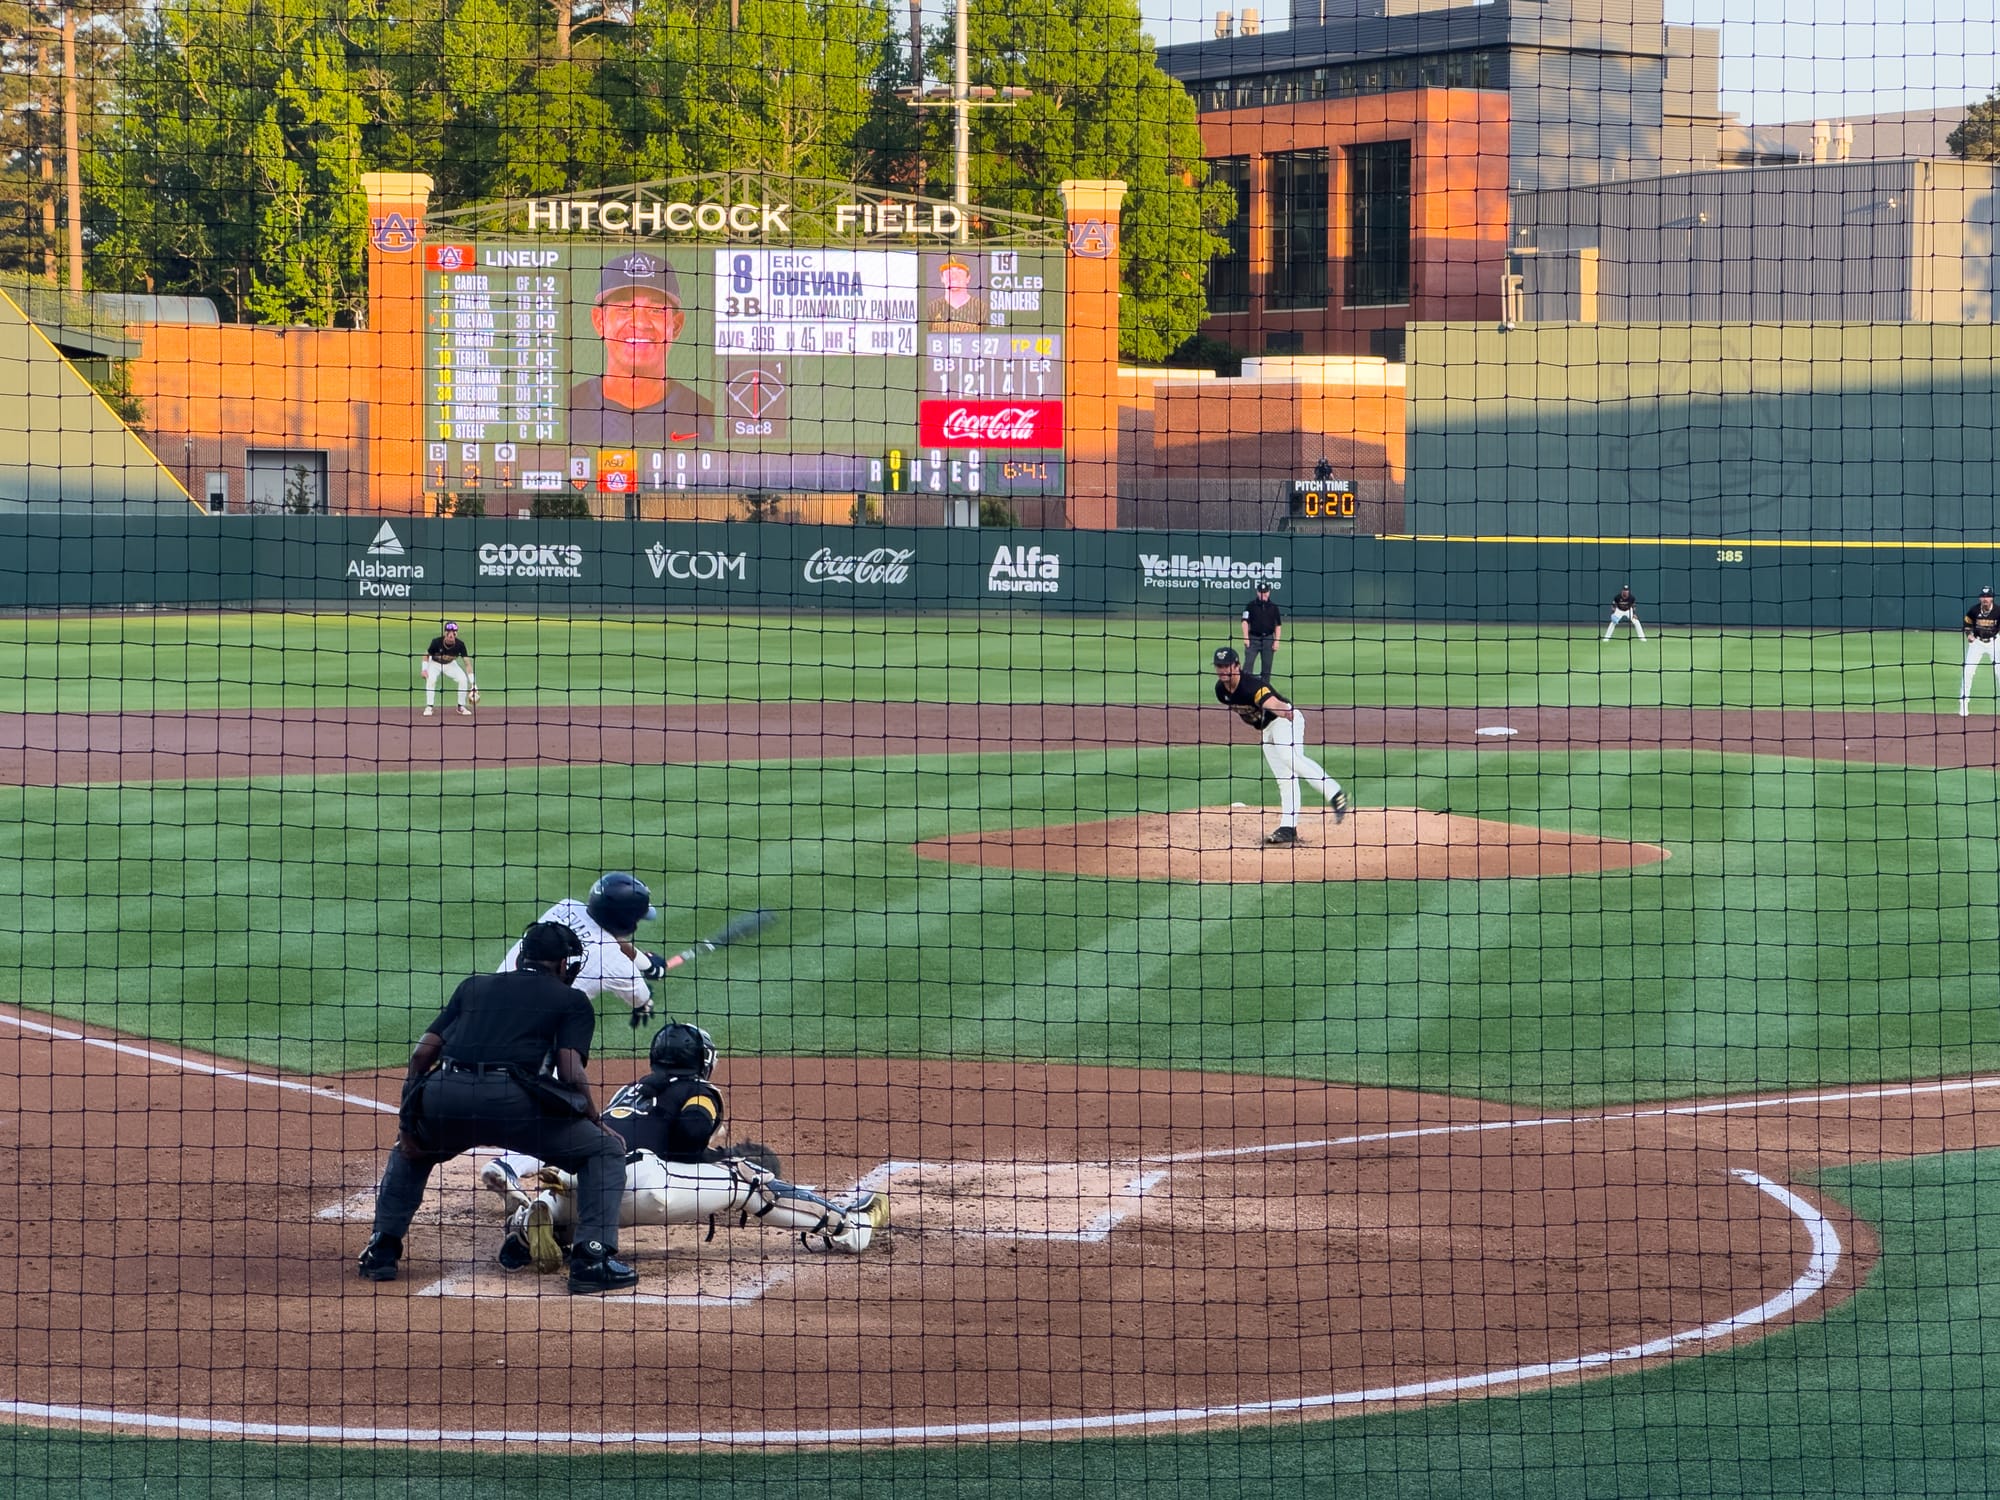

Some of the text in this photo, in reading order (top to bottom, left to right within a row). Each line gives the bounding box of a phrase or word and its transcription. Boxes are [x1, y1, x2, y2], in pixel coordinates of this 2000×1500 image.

[527, 200, 962, 233] HITCHCOCK FIELD
[485, 250, 559, 267] LINEUP
[773, 255, 813, 269] ERIC
[998, 253, 1012, 271] 19
[733, 254, 753, 294] 8
[990, 276, 1043, 289] CALEB
[455, 275, 488, 290] CARTER
[536, 276, 555, 291] 1-2
[772, 271, 863, 297] GUEVARA
[724, 297, 761, 317] 3B
[990, 291, 1039, 311] SANDERS
[772, 300, 784, 319] JR
[796, 300, 840, 319] PANAMA
[871, 300, 916, 320] PANAMA
[455, 313, 494, 328] GUEVARA
[516, 314, 530, 329] 3B
[536, 314, 555, 329] 0-0
[990, 313, 1005, 327] SR
[718, 330, 745, 347] AVG
[801, 327, 816, 352] 45
[825, 331, 843, 348] HR
[848, 327, 856, 352] 5
[871, 331, 894, 348] RBI
[898, 327, 912, 353] 24
[932, 340, 943, 352] B
[971, 340, 980, 352] S
[984, 338, 999, 355] 27
[1011, 339, 1030, 352] TP
[455, 351, 490, 365] TERRELL
[518, 352, 528, 366] LF
[536, 352, 553, 366] 0-1
[933, 359, 1051, 372] BB IP H ER
[776, 362, 783, 374] 1
[940, 374, 948, 396] 1
[964, 374, 985, 396] 2.1
[1037, 374, 1043, 395] 1
[455, 387, 498, 401] GREGORIO
[517, 406, 530, 421] SS
[455, 424, 485, 438] STEELE
[520, 425, 527, 439] C
[735, 421, 772, 434] Sac8
[943, 408, 1040, 440] Coca-Cola
[432, 446, 443, 459] B
[466, 446, 476, 459] S
[653, 453, 711, 469] 0 0 0
[436, 465, 444, 487] 1
[464, 465, 480, 487] 2
[576, 461, 584, 476] 3
[871, 461, 881, 481] R
[952, 461, 961, 482] E
[1003, 462, 1048, 480] 6:41
[654, 472, 686, 489] 1 0
[891, 471, 899, 491] 1
[930, 471, 941, 491] 4
[1295, 481, 1349, 491] PITCH TIME
[1306, 493, 1354, 515] 0:20
[479, 543, 582, 566] COOK'S
[645, 541, 746, 580] VCOM
[990, 545, 1059, 578] Alfa
[1716, 550, 1743, 562] 385
[347, 560, 424, 579] Alabama
[479, 565, 581, 577] PEST CONTROL
[803, 547, 916, 584] Coca-Cola
[1139, 554, 1282, 579] YellaWood
[359, 581, 411, 597] Power
[988, 576, 1058, 592] Insurance
[1144, 578, 1199, 589] Pressure
[1202, 578, 1250, 590] Treated
